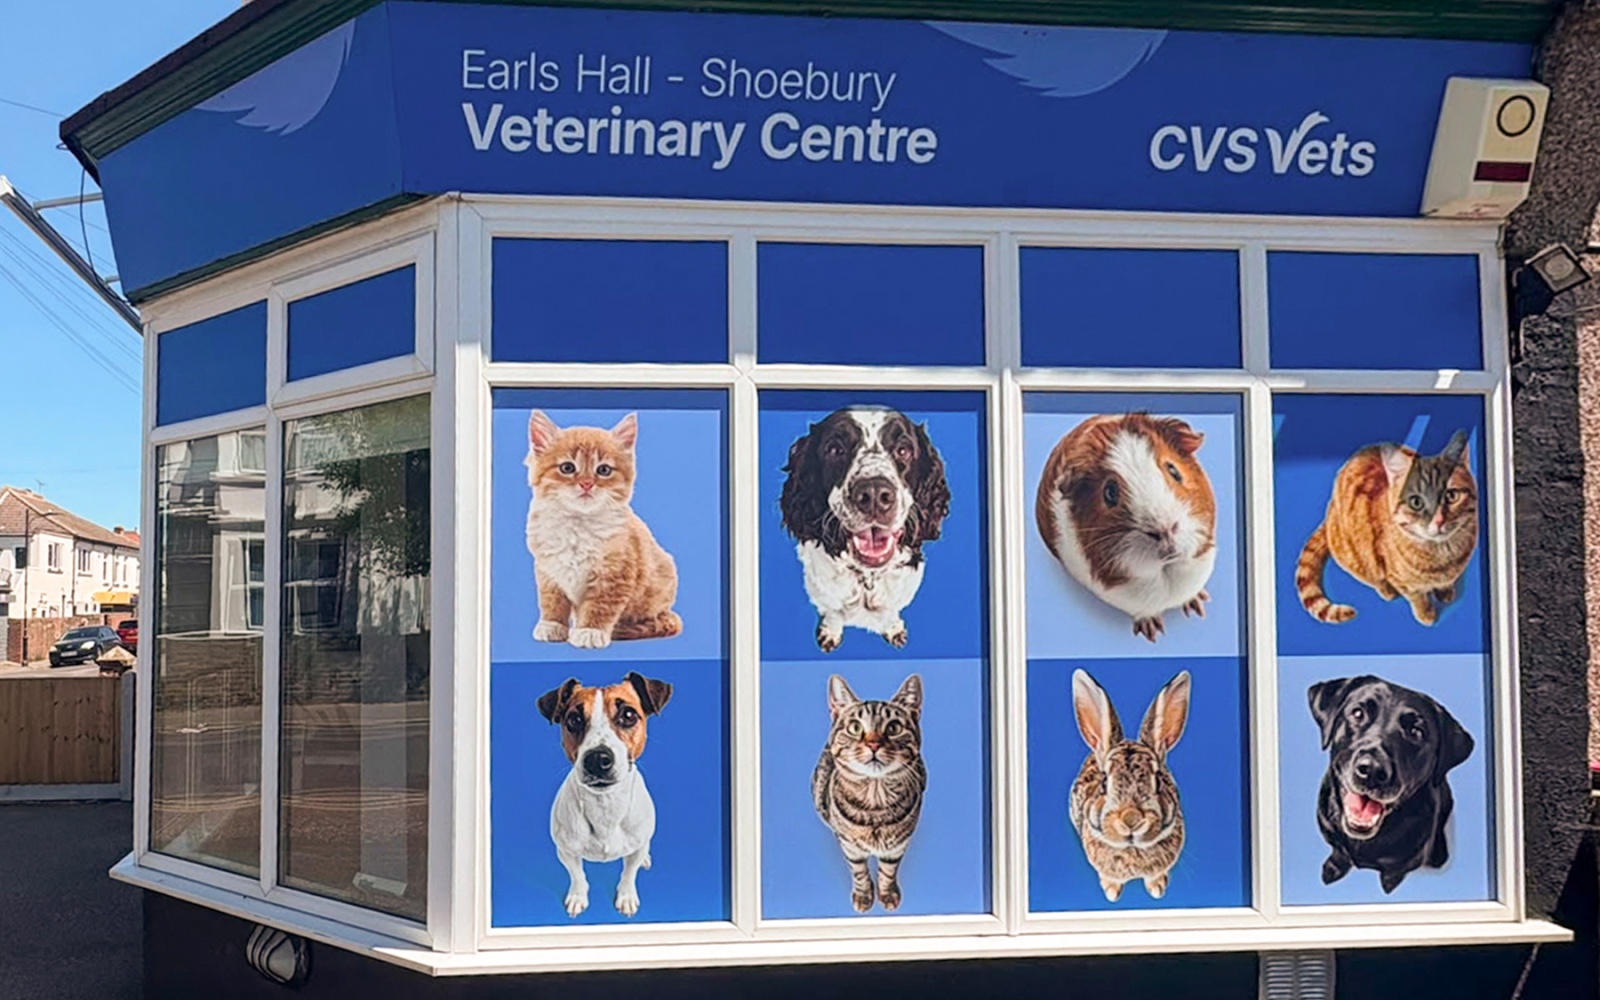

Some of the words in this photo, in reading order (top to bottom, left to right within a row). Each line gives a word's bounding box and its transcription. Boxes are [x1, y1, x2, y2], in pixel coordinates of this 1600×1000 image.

[462, 49, 560, 92] Earls
[577, 54, 650, 95] Hall
[701, 58, 896, 112] Shoebury
[462, 102, 746, 170] Veterinary
[760, 112, 937, 164] Centre
[1150, 125, 1258, 174] CVS
[1265, 111, 1376, 176] Vets
